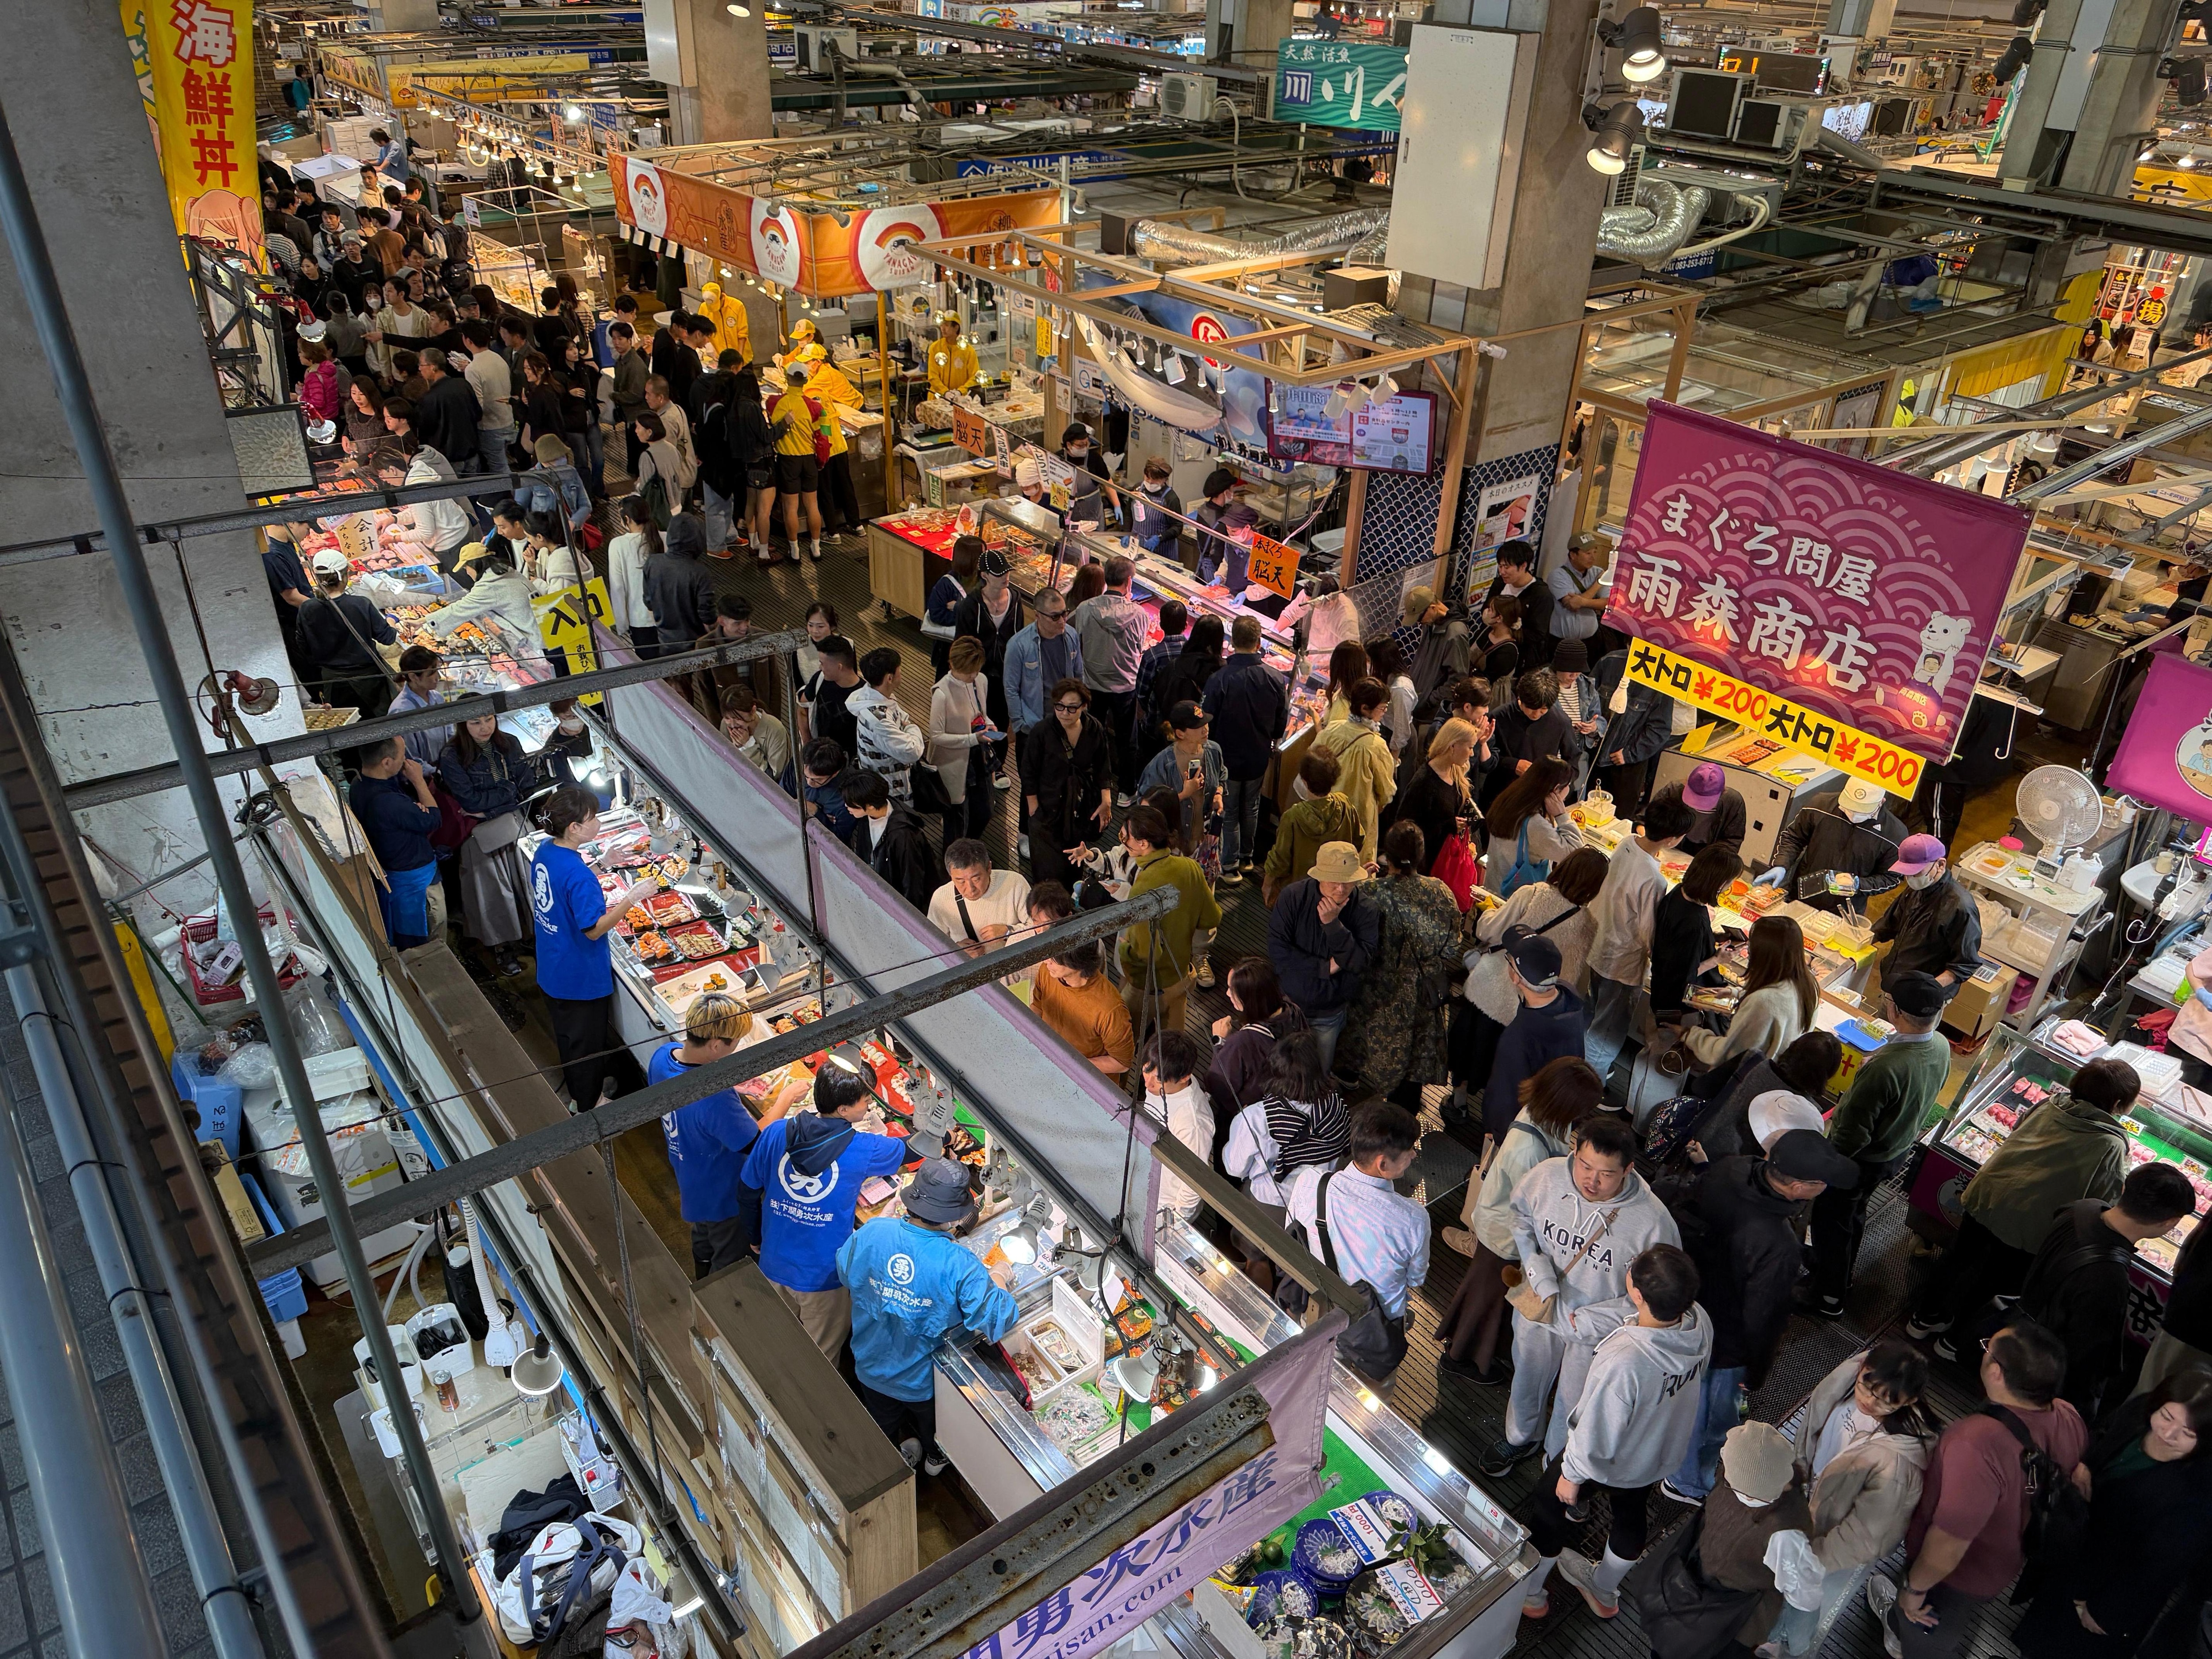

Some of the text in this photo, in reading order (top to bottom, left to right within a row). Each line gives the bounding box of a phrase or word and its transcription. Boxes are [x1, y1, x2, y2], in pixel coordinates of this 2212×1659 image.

[1285, 44, 1351, 63] 天然 活魚
[169, 0, 238, 188] 海鮮丼
[766, 243, 787, 264] YANAGAWA
[1664, 261, 1675, 272] FAX
[889, 266, 915, 276] SUISAN
[2137, 300, 2163, 324] 揚
[956, 419, 983, 453] 脳天
[1487, 479, 1533, 499] 本日のオススメ
[354, 518, 375, 552] 会計
[1662, 493, 1879, 606] まぐろ問屋
[1252, 559, 1286, 590] 脳天
[1627, 550, 1877, 693] 雨森商店
[1898, 687, 1928, 707] 雨森商店
[1630, 646, 1920, 788] 大トロ ¥200 大トロ ¥200
[1742, 908, 1755, 920] fatty
[1543, 1218, 1613, 1267] KOREA
[1348, 1504, 1374, 1535] 1000円
[1379, 1569, 1417, 1622] 天然まふぐ刺身
[1404, 1561, 1442, 1606] 1000円
